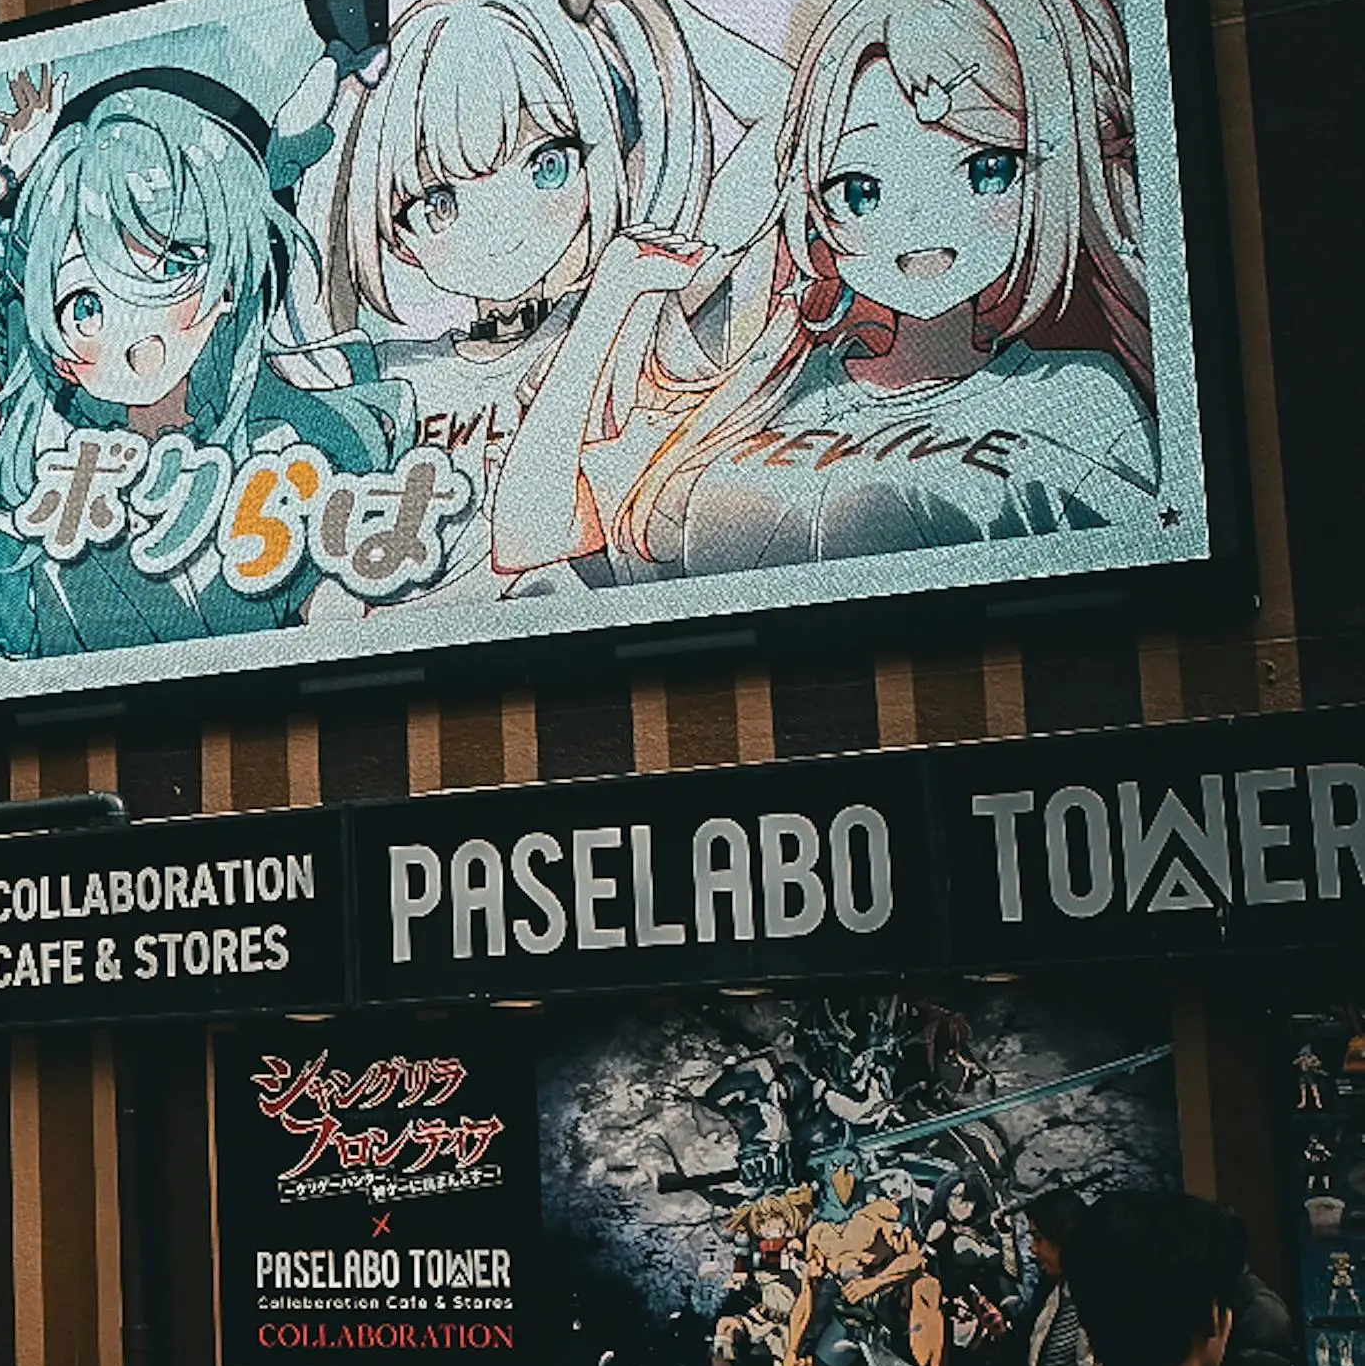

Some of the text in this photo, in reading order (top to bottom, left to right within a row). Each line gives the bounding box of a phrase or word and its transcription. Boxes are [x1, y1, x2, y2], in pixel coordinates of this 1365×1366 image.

[22, 435, 462, 583] ボクらは
[971, 760, 1365, 925] TOWER
[388, 804, 894, 963] PASELABO
[94, 937, 123, 981] &
[133, 924, 290, 979] STORES
[250, 1048, 469, 1118] シャングリラ
[277, 1113, 506, 1181] フロンティア
[255, 1249, 512, 1289] PASELABO TOWER
[256, 1295, 381, 1311] Collaboration
[385, 1295, 429, 1311] Cafe
[452, 1295, 515, 1311] Stores
[257, 1322, 515, 1351] COLLABORATION
